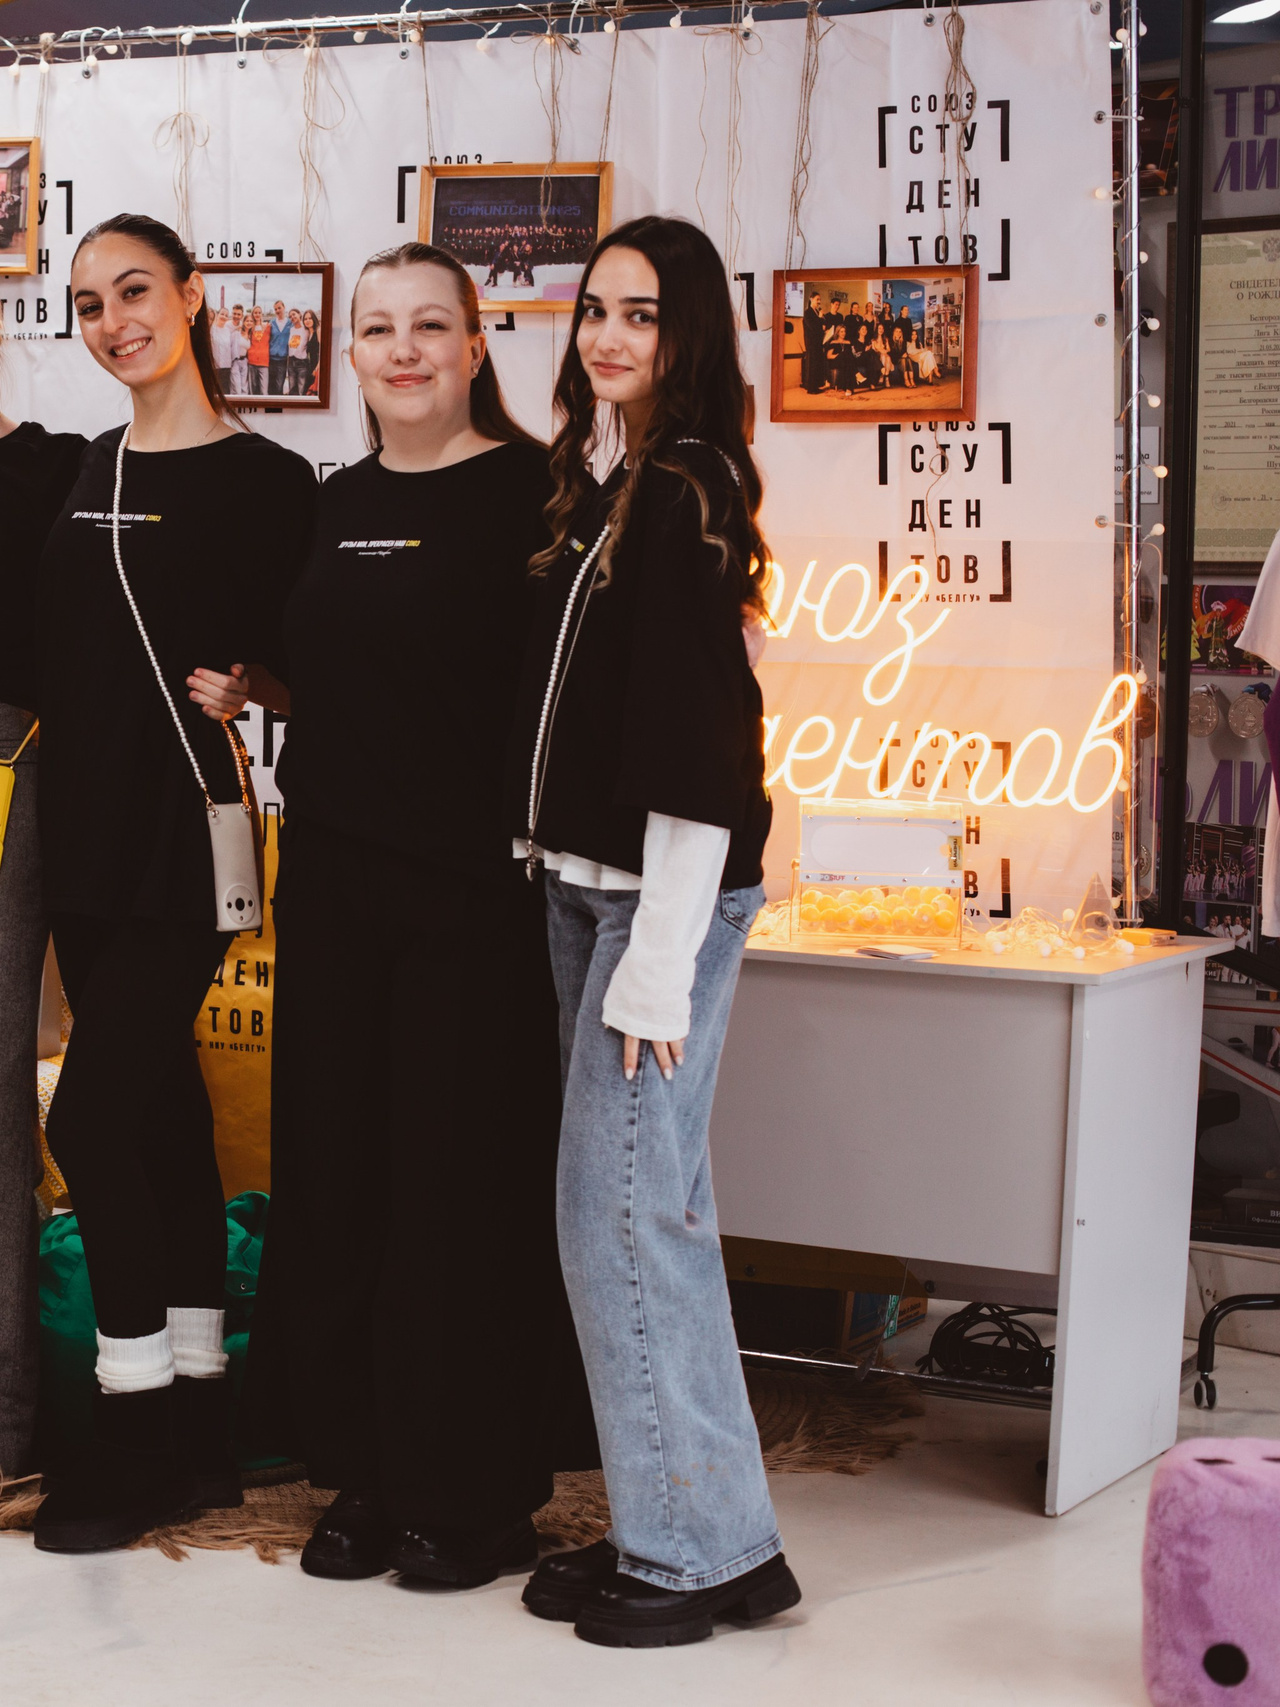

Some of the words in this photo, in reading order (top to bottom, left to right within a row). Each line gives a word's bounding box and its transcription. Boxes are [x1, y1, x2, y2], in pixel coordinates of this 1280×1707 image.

[911, 92, 975, 113] СОЮЗ
[909, 122, 977, 154] СТУ
[906, 178, 980, 214] ДЕН
[206, 241, 256, 259] СОЮЗ
[908, 234, 978, 265] ТОВ
[910, 444, 979, 473] СТУ
[908, 499, 981, 532] ДЕН
[910, 555, 979, 583] ТОВ
[209, 1006, 264, 1036] ТОВ
